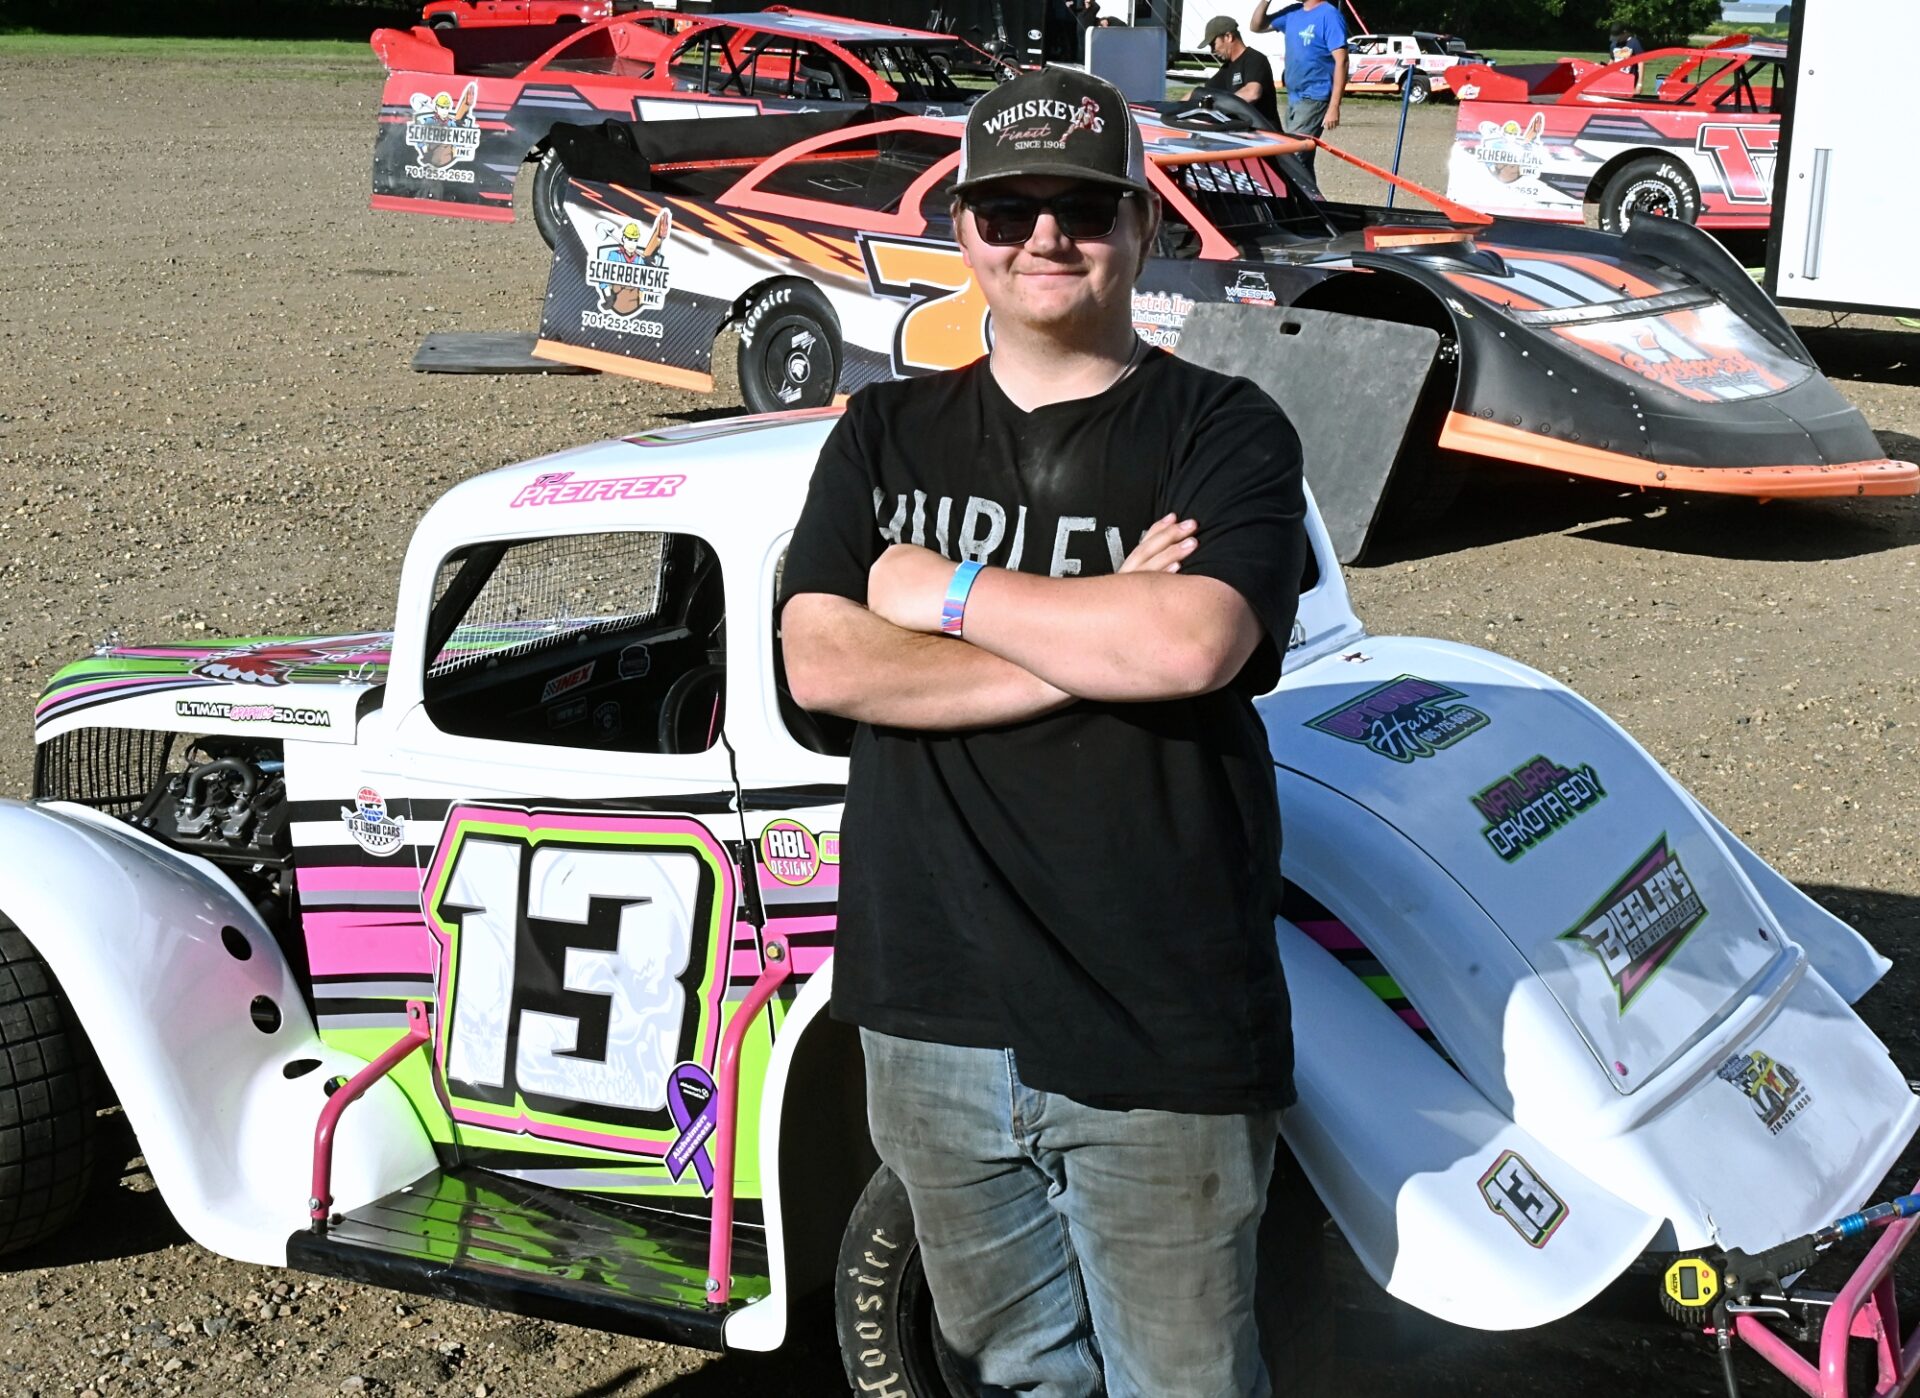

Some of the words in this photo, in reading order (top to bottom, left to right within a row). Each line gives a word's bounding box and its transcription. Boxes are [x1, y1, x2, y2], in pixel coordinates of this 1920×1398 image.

[1350, 57, 1397, 82] 77
[408, 125, 478, 145] SCHERBENSKE
[996, 123, 1051, 147] Finest
[1015, 140, 1041, 150] SINCE
[456, 147, 471, 156] INC
[406, 167, 474, 182] 701-252-2652
[1655, 163, 1695, 210] Hoosier
[589, 260, 669, 289] SCHERBENSKE
[643, 293, 660, 303] INC
[1225, 286, 1276, 300] WISSOTA
[583, 313, 662, 336] 701-252-2652
[741, 288, 792, 349] Hoosier
[511, 475, 686, 507] PFEIFFER
[873, 487, 1147, 578] HURLE
[176, 702, 331, 726] ULTIMATEGRAPHICSSD.COM
[1319, 678, 1446, 738] UPTOWN
[1371, 708, 1436, 755] Hair
[1474, 759, 1568, 820] NATURAL
[1487, 791, 1567, 855] DAKOTA
[1557, 767, 1599, 806] SOY
[361, 820, 381, 834] LEGEND
[382, 825, 400, 837] CARS
[767, 830, 811, 859] RBL
[771, 859, 814, 877] DESIGNS
[1578, 860, 1692, 977] BIEGLER'S
[443, 837, 700, 1112] 13
[672, 1114, 708, 1160] Alzheimers
[678, 1122, 712, 1165] Awareness
[1485, 1155, 1559, 1241] 13
[847, 1228, 907, 1398] Hoosier
